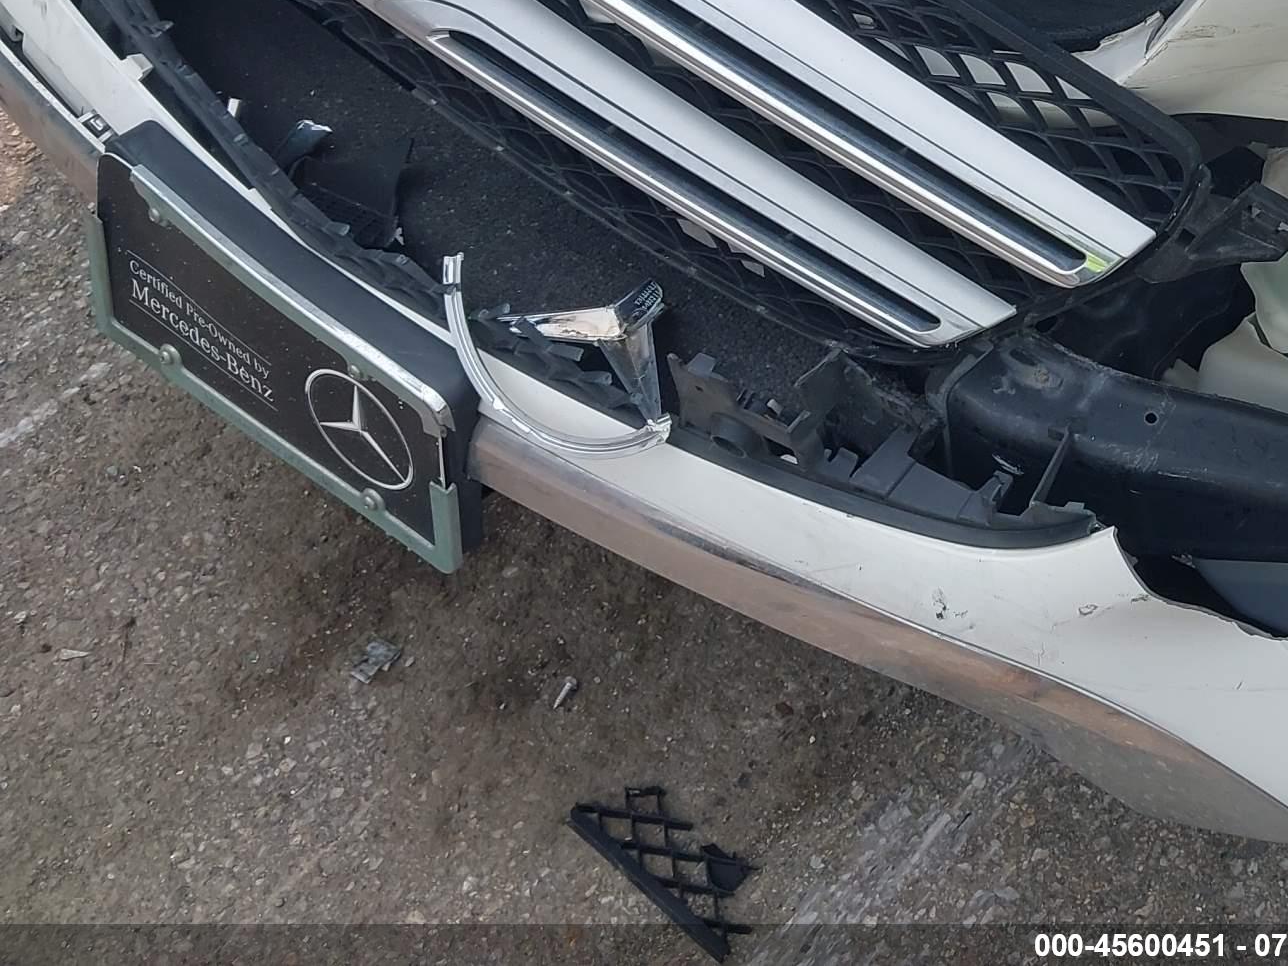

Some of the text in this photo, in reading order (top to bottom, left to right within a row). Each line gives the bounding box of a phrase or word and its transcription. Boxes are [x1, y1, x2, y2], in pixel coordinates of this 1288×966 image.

[129, 260, 270, 379] Certified Pre-Owned by
[132, 278, 274, 402] Mercedes-Benz
